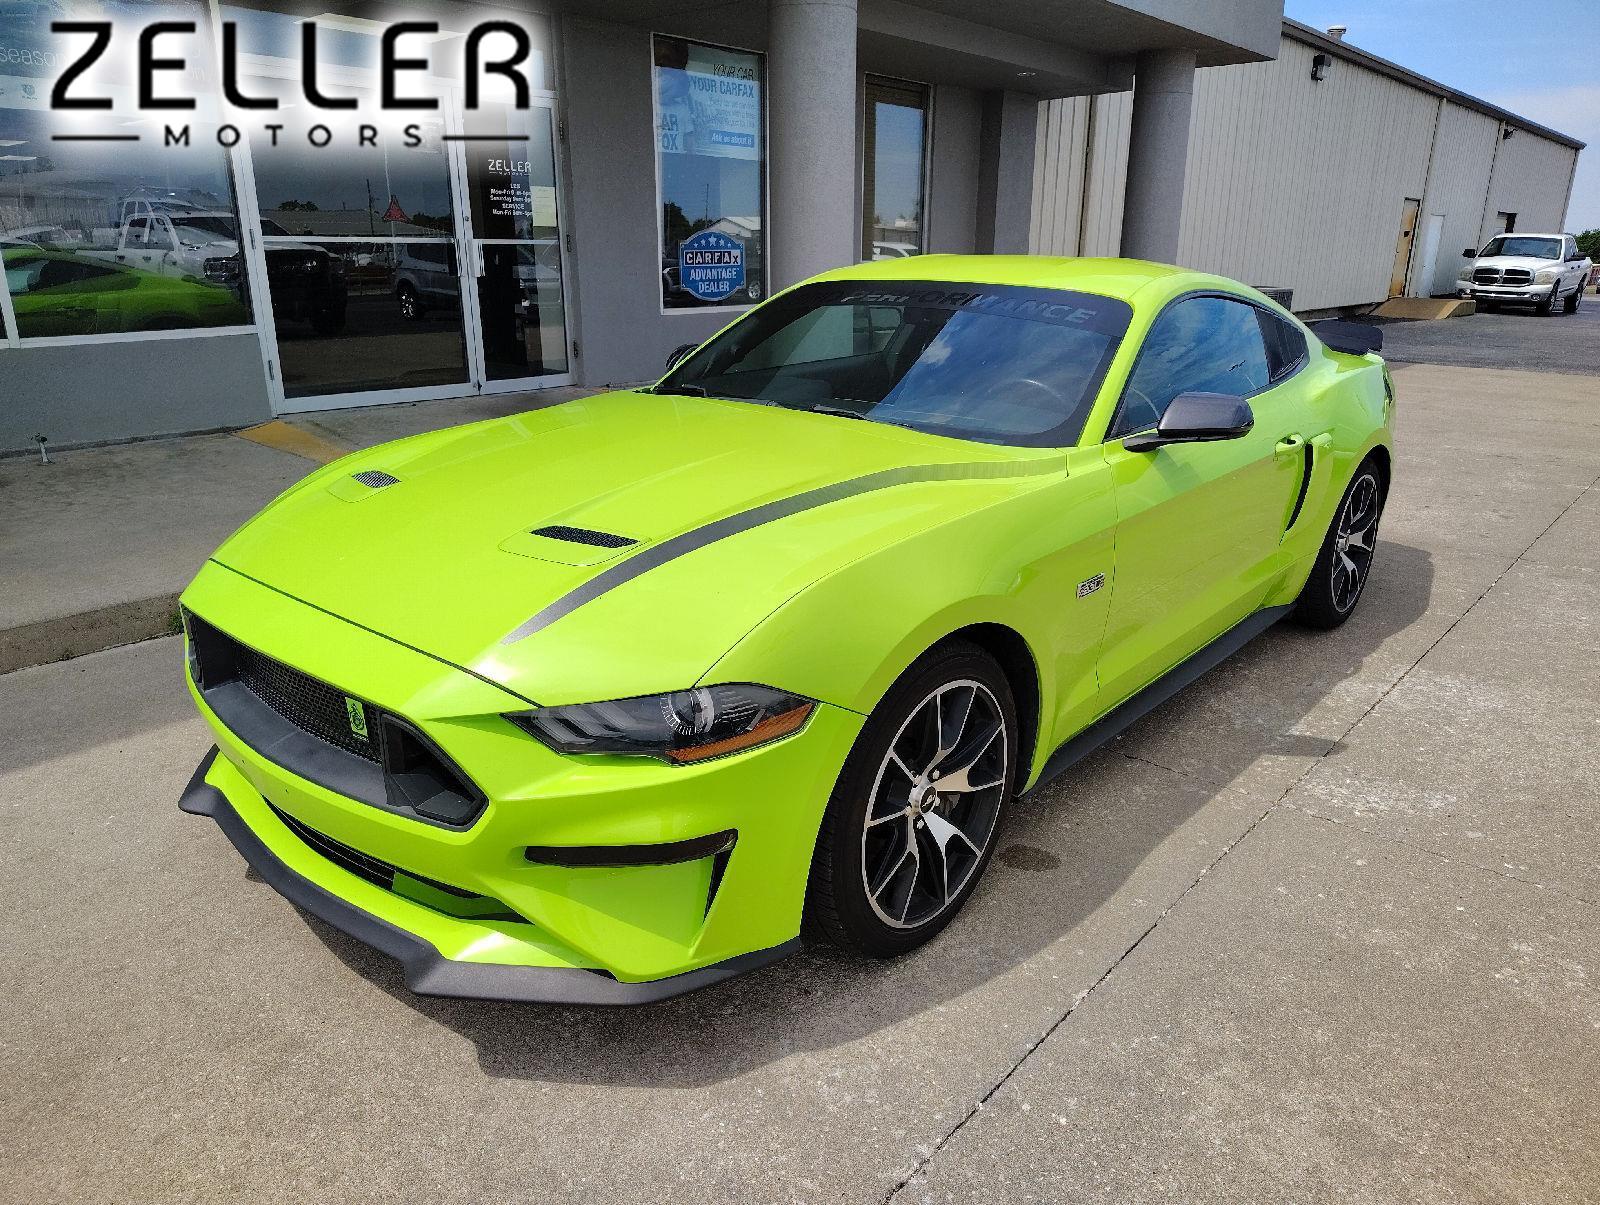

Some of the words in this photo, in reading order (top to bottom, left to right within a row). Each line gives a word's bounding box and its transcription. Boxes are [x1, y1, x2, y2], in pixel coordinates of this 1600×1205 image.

[691, 75, 717, 93] YOUR
[719, 80, 754, 98] CARFAX
[711, 133, 722, 142] Ask
[487, 159, 532, 173] ZELLER
[685, 251, 739, 264] CARFAX
[690, 268, 736, 280] ADVANTAGE
[698, 281, 730, 293] DEALER
